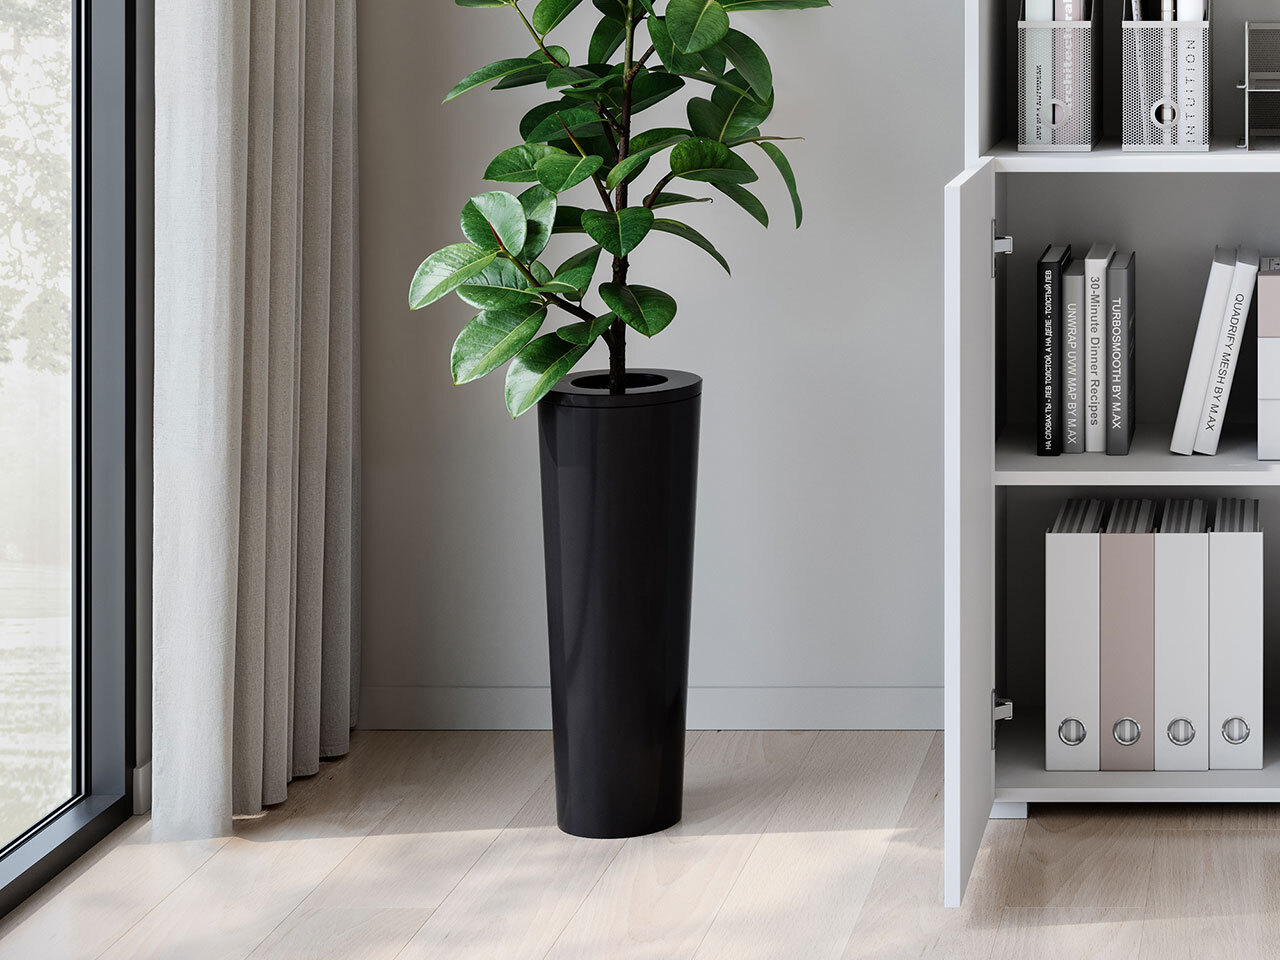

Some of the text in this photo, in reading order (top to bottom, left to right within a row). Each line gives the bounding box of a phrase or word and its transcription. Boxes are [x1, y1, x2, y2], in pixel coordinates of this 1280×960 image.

[1068, 304, 1076, 444] UNWRAP UVW MAP BY M.AX
[1088, 276, 1100, 426] 30-Minute Dinner Recipes
[1112, 298, 1121, 429] TURBOSMOOTH BY M.AX
[1205, 293, 1244, 431] QUADRIFY MESH BY M.AX
[1044, 440, 1052, 450] НА
